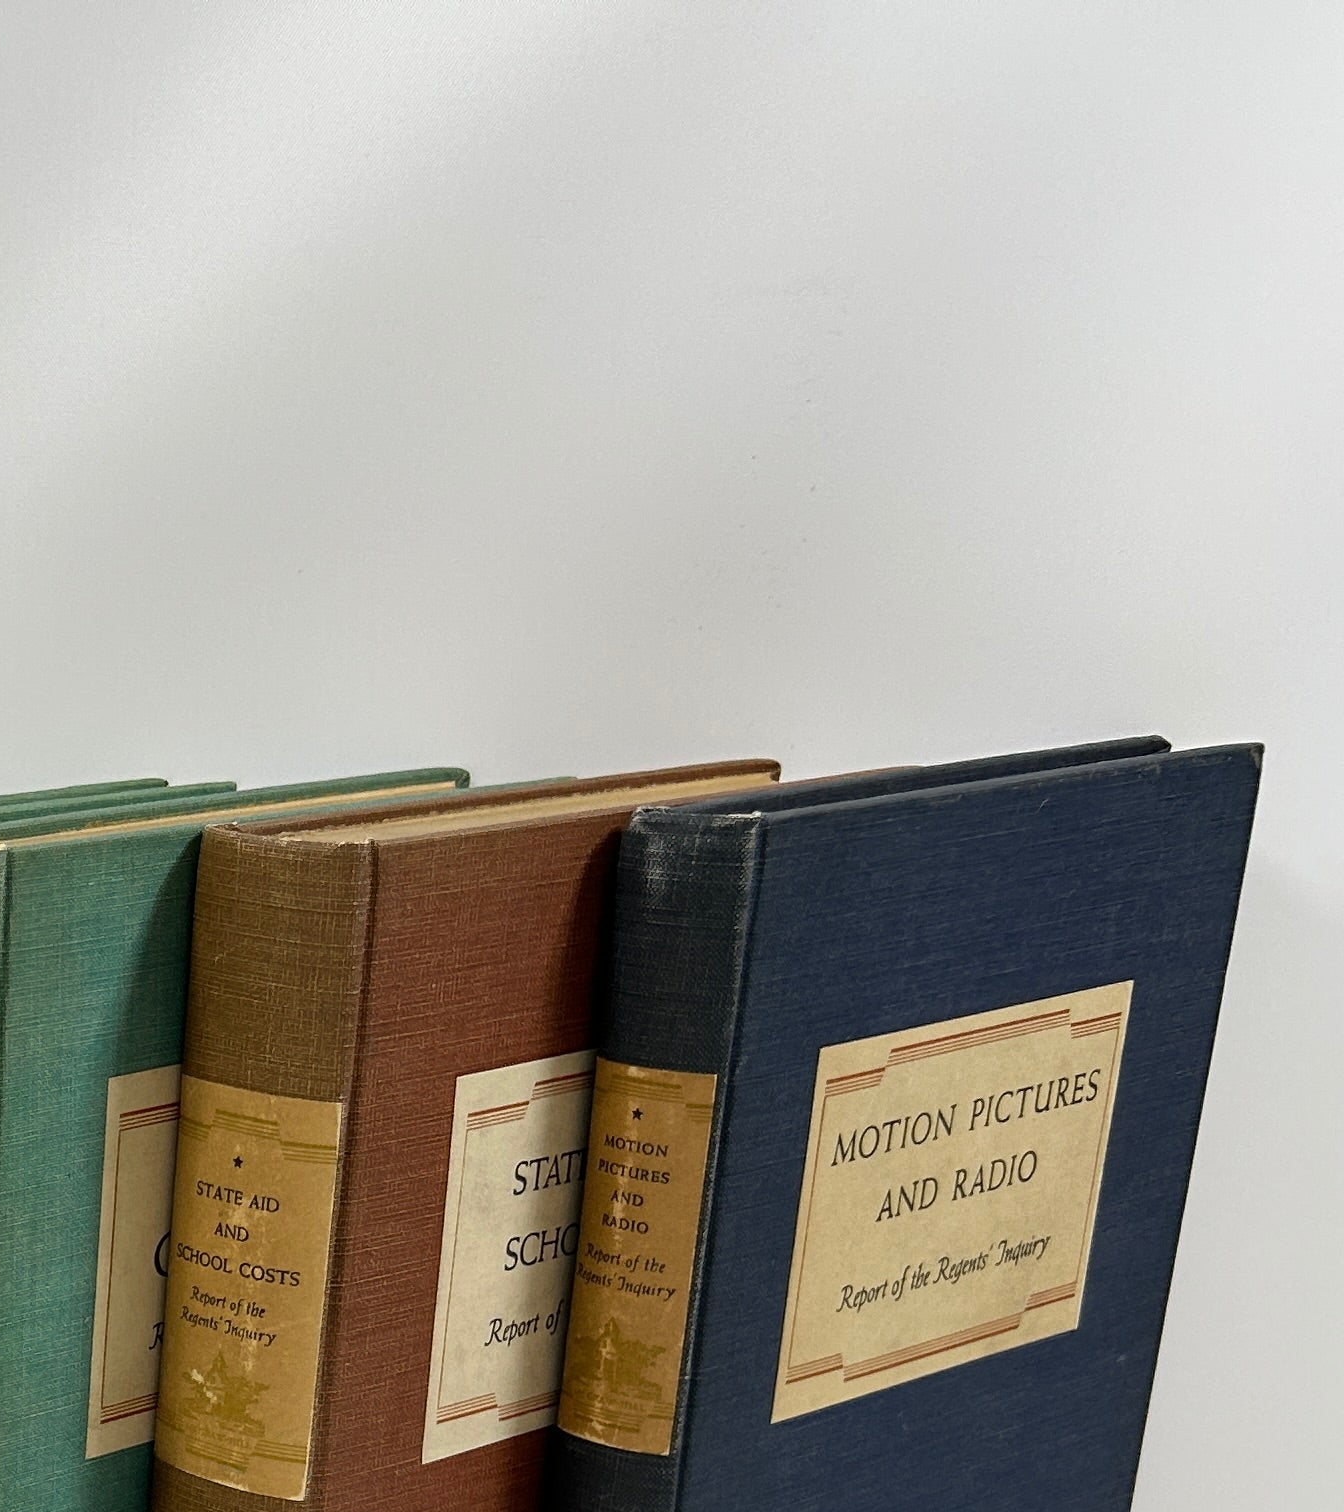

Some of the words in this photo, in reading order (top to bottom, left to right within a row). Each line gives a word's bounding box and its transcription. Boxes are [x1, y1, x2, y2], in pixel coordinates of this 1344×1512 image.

[830, 1103, 958, 1168] MOTION
[968, 1067, 1102, 1132] PICTURES
[603, 1134, 670, 1158] MOTION
[597, 1157, 671, 1185] PICTURES
[875, 1177, 938, 1222] AND
[951, 1150, 1038, 1201] RADIO
[196, 1180, 243, 1206] STATE
[248, 1194, 280, 1214] AID
[610, 1189, 644, 1208] AND
[213, 1222, 249, 1243] AND
[601, 1213, 649, 1235] RADIO
[176, 1242, 232, 1274] SCHOOL
[238, 1262, 300, 1287] COSTS
[504, 1222, 581, 1272] SCHO
[584, 1242, 621, 1266] Report
[625, 1255, 640, 1272] of
[644, 1257, 666, 1274] the
[576, 1262, 618, 1288] Regents'
[617, 1275, 677, 1302] Inquiry
[835, 1280, 889, 1314] Report
[890, 1265, 912, 1302] of
[912, 1265, 930, 1292] the
[932, 1244, 994, 1284] Regents'
[996, 1234, 1052, 1269] Inquiry
[189, 1285, 227, 1309] Report
[229, 1298, 243, 1317] of
[245, 1301, 266, 1319] the
[179, 1305, 223, 1332] Regents'
[223, 1319, 277, 1347] Inquiry
[484, 1313, 539, 1347] Report
[545, 1298, 565, 1335] of
